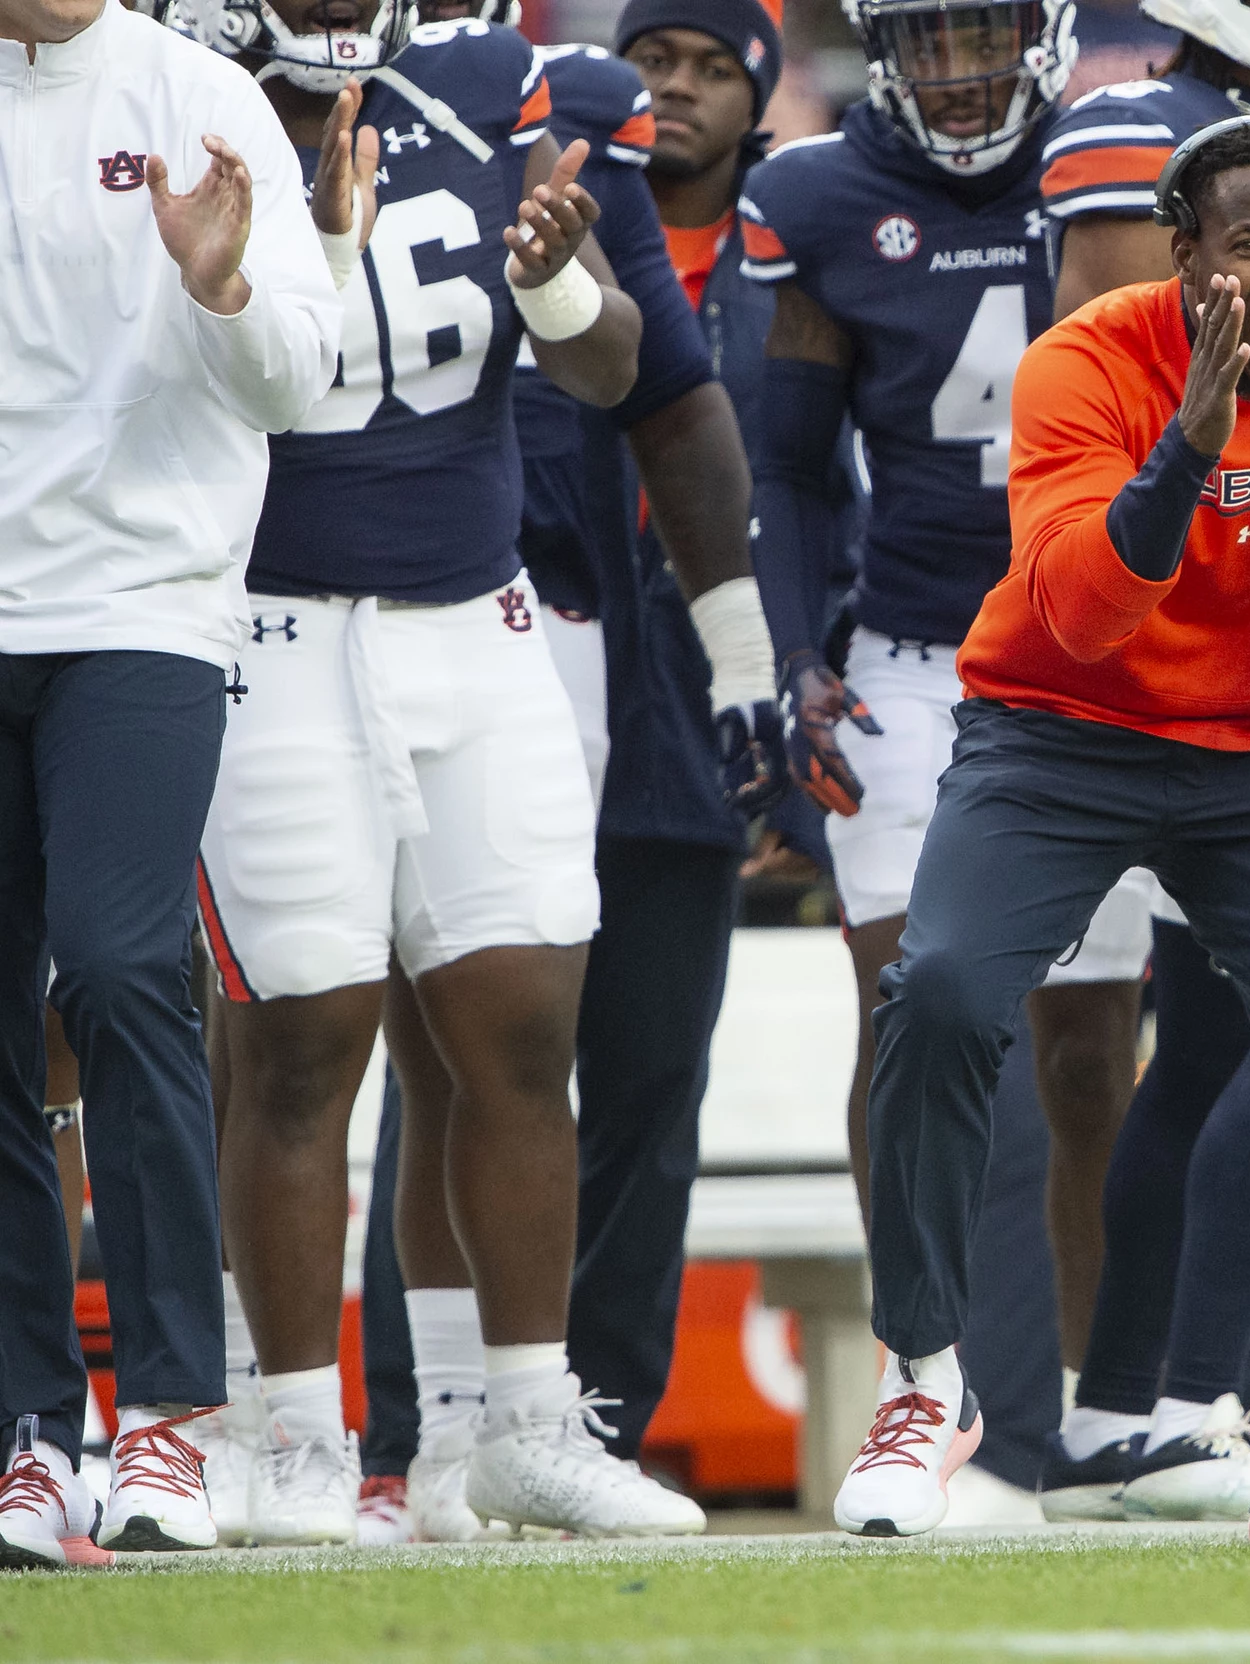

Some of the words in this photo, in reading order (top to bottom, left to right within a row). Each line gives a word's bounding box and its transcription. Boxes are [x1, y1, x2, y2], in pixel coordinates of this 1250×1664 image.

[98, 150, 147, 192] AU
[873, 214, 921, 262] SEC
[928, 244, 1027, 273] AUBURN
[931, 283, 1029, 488] 4
